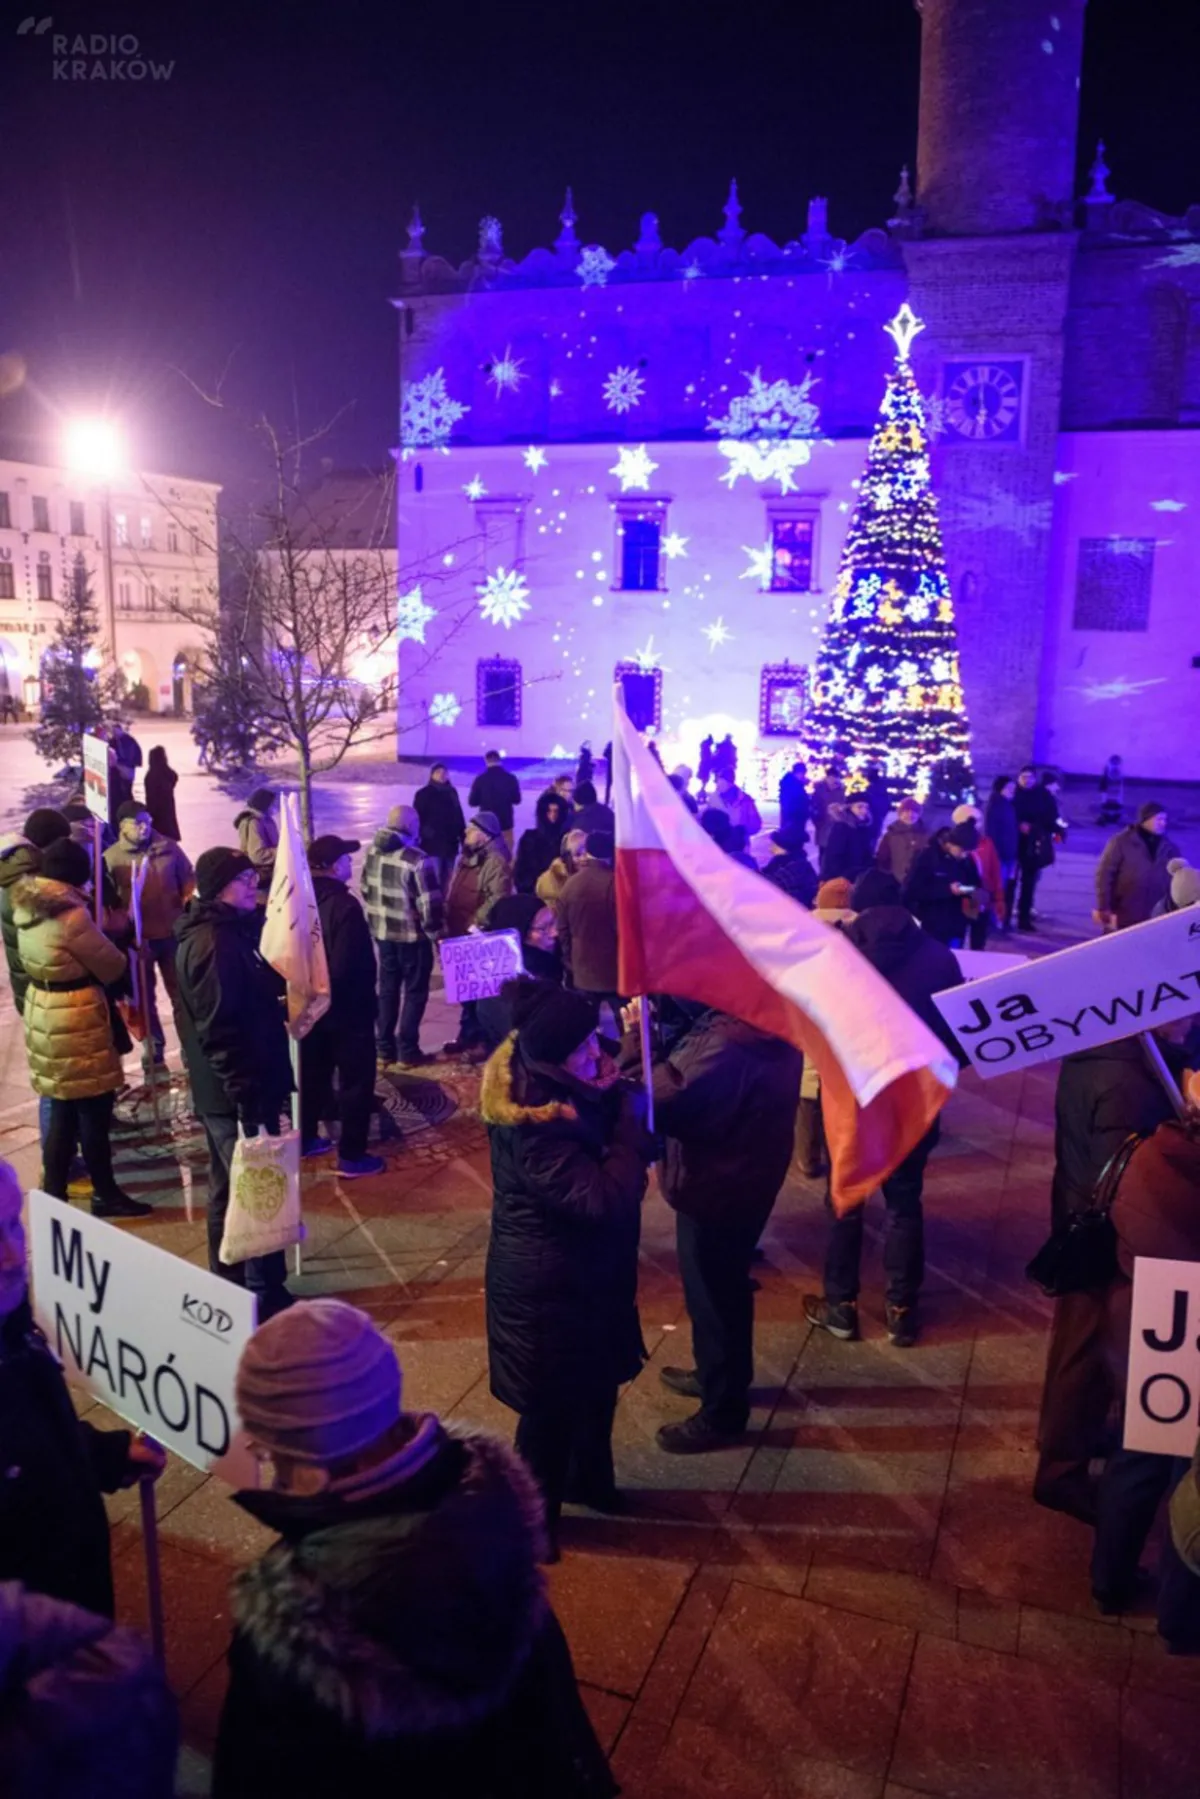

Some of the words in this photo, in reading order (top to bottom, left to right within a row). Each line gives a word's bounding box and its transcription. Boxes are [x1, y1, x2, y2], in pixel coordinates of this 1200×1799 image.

[454, 956, 512, 982] NASZE
[958, 993, 1039, 1035] Ja
[51, 1217, 111, 1315] My
[181, 1293, 233, 1334] KOD
[1142, 1289, 1200, 1352] J
[55, 1301, 231, 1457] NARÓD
